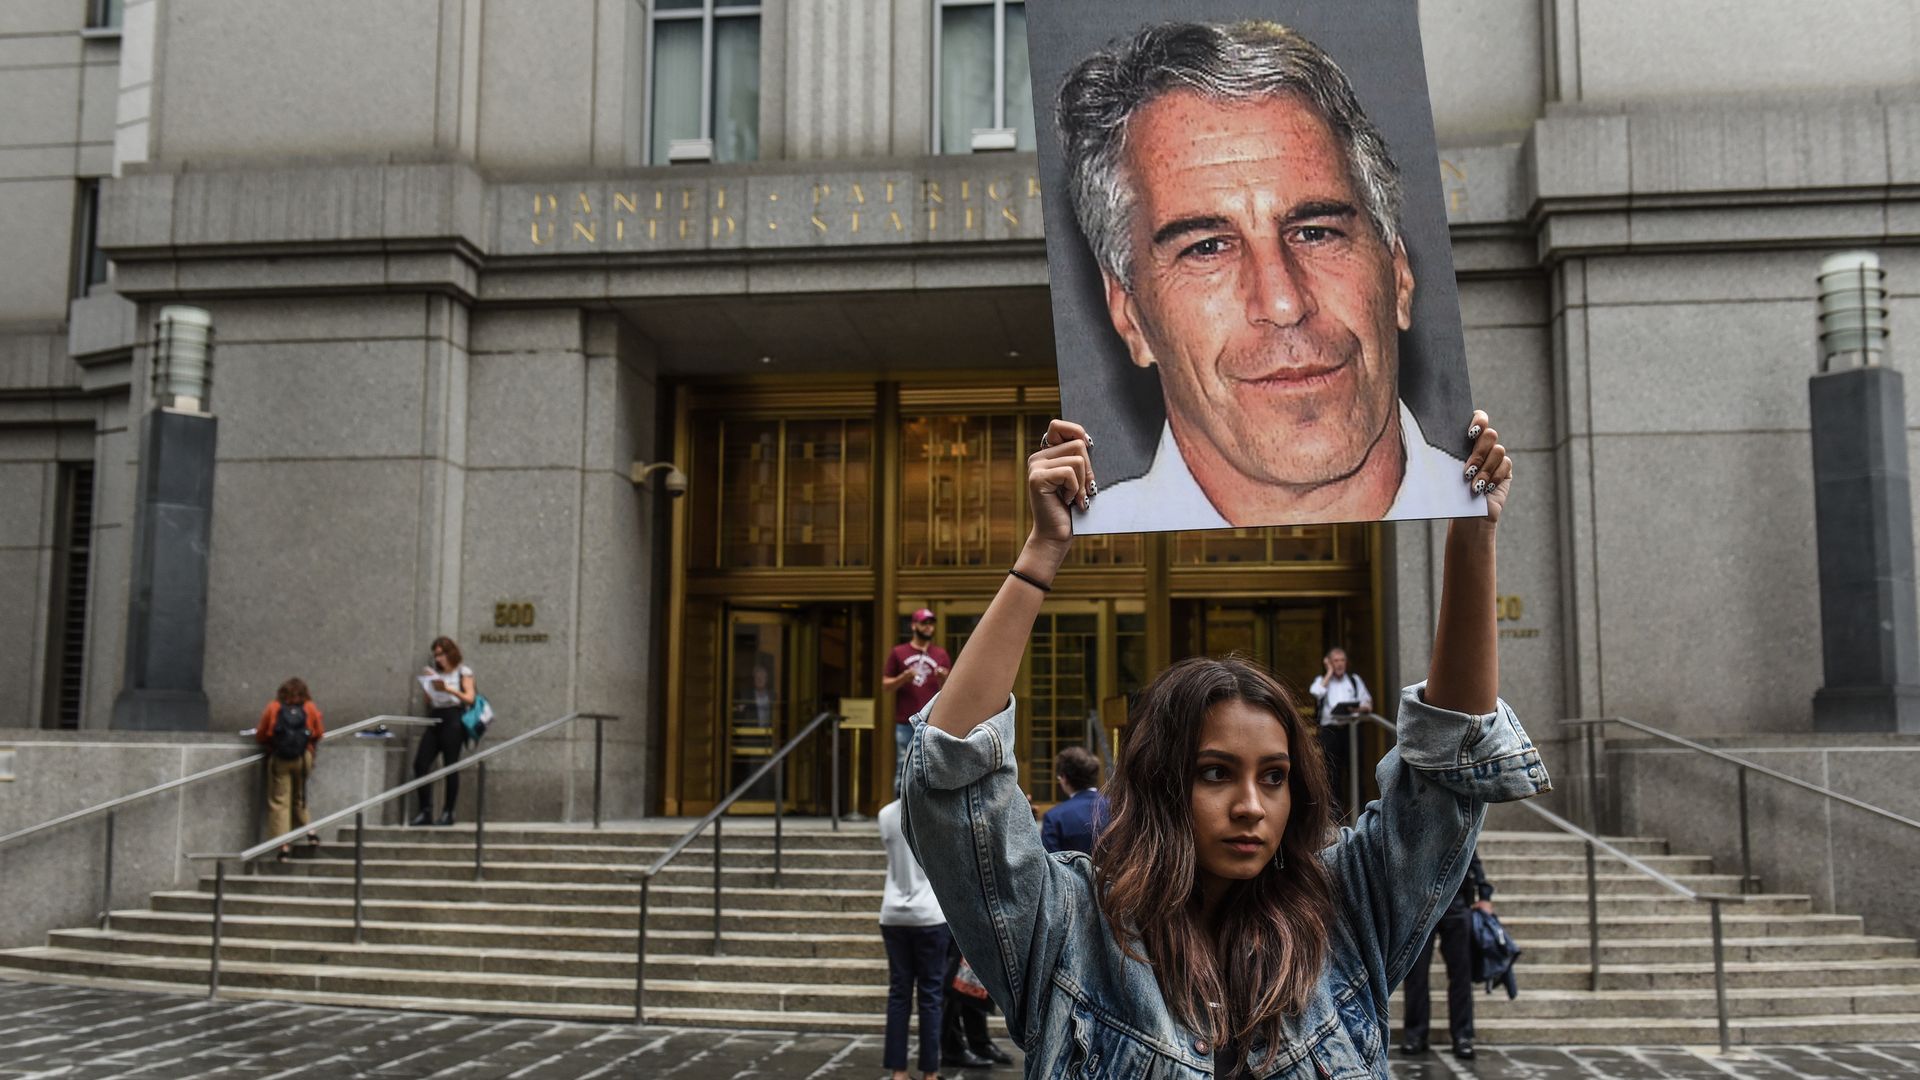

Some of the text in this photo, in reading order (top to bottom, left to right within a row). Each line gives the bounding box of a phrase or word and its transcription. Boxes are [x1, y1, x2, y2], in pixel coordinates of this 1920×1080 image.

[533, 186, 731, 215] DANIEL
[531, 206, 1019, 245] UNITED STATES
[495, 602, 534, 628] 500
